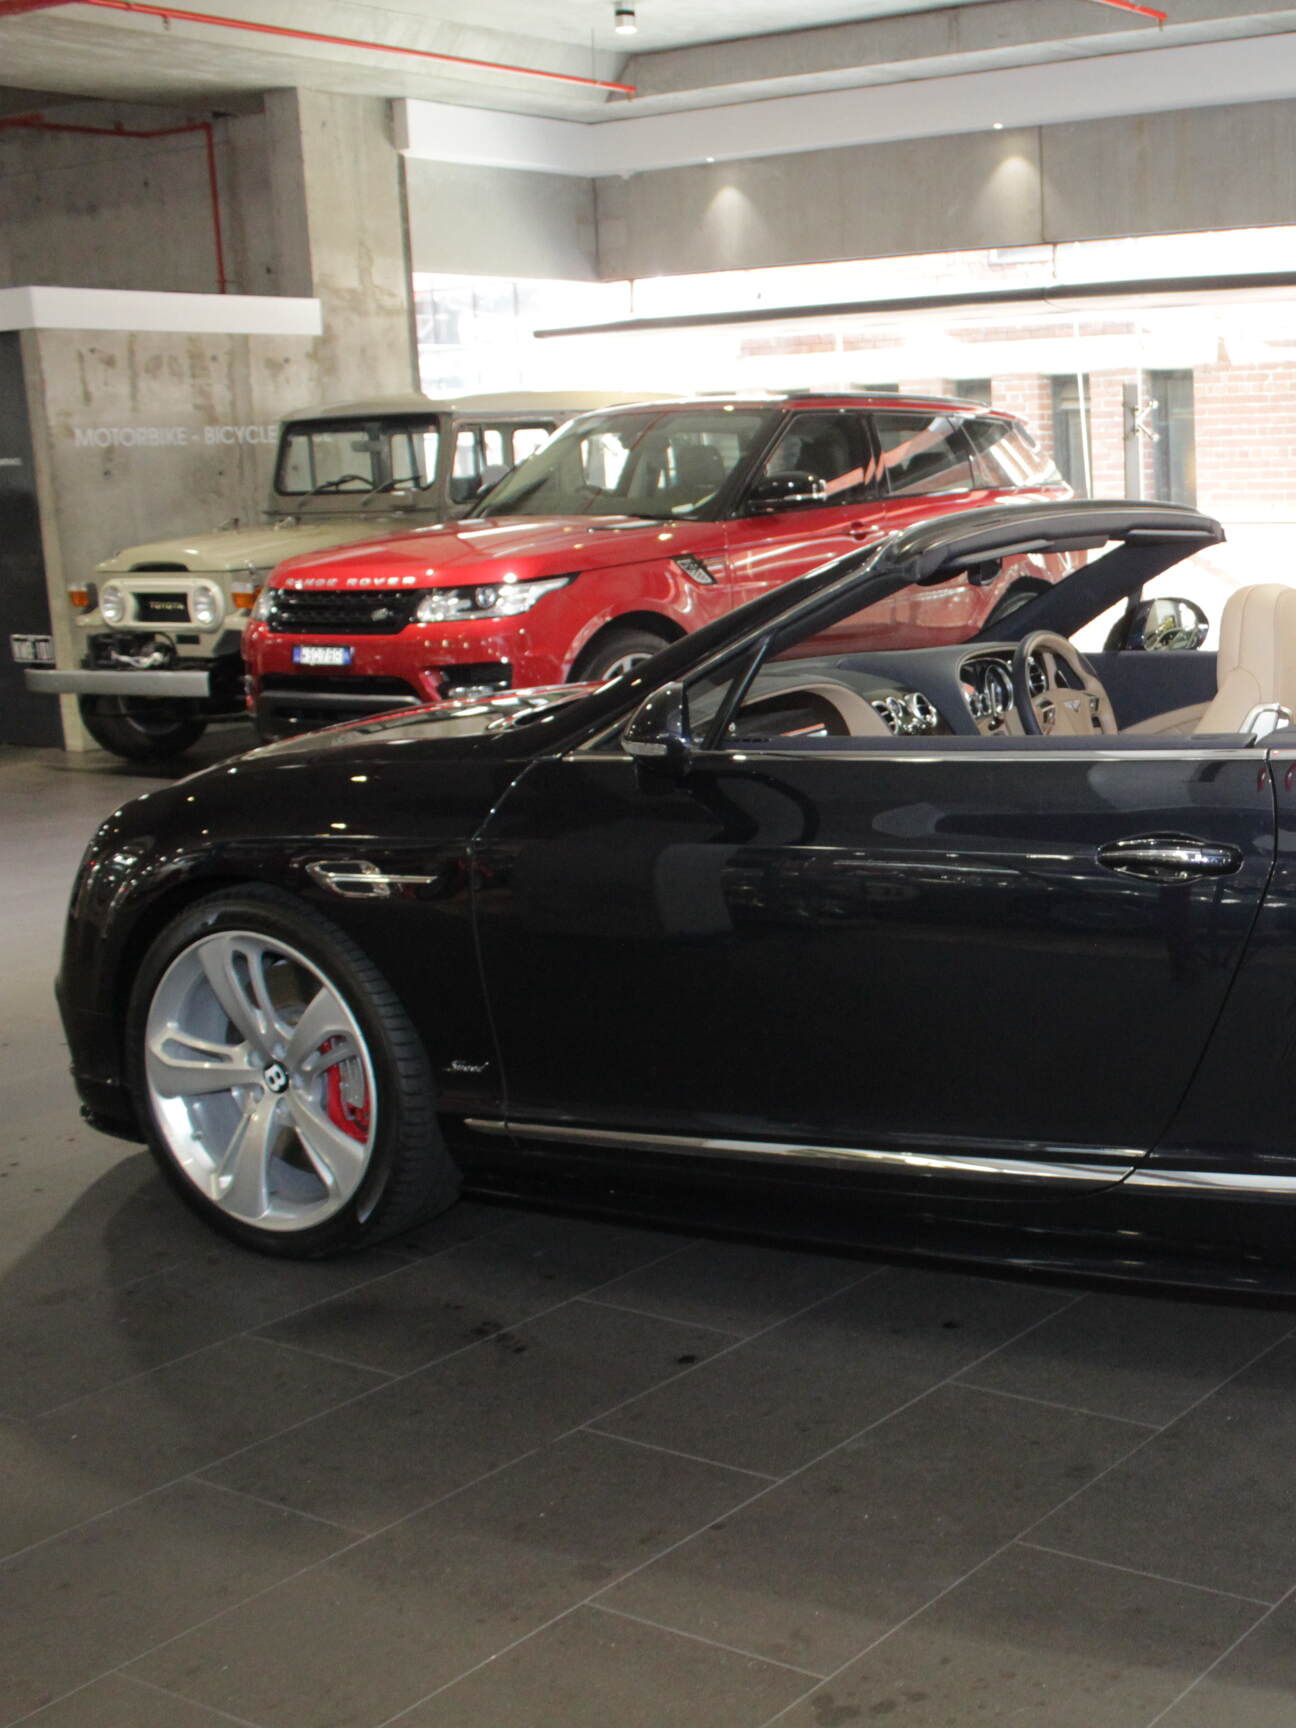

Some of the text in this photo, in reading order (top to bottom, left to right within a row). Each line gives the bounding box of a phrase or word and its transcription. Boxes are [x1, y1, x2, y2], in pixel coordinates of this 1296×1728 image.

[74, 426, 188, 448] MOTORBIKE
[204, 424, 276, 444] BICYCLE
[346, 575, 416, 587] ROVER
[148, 601, 186, 611] TOYOTA
